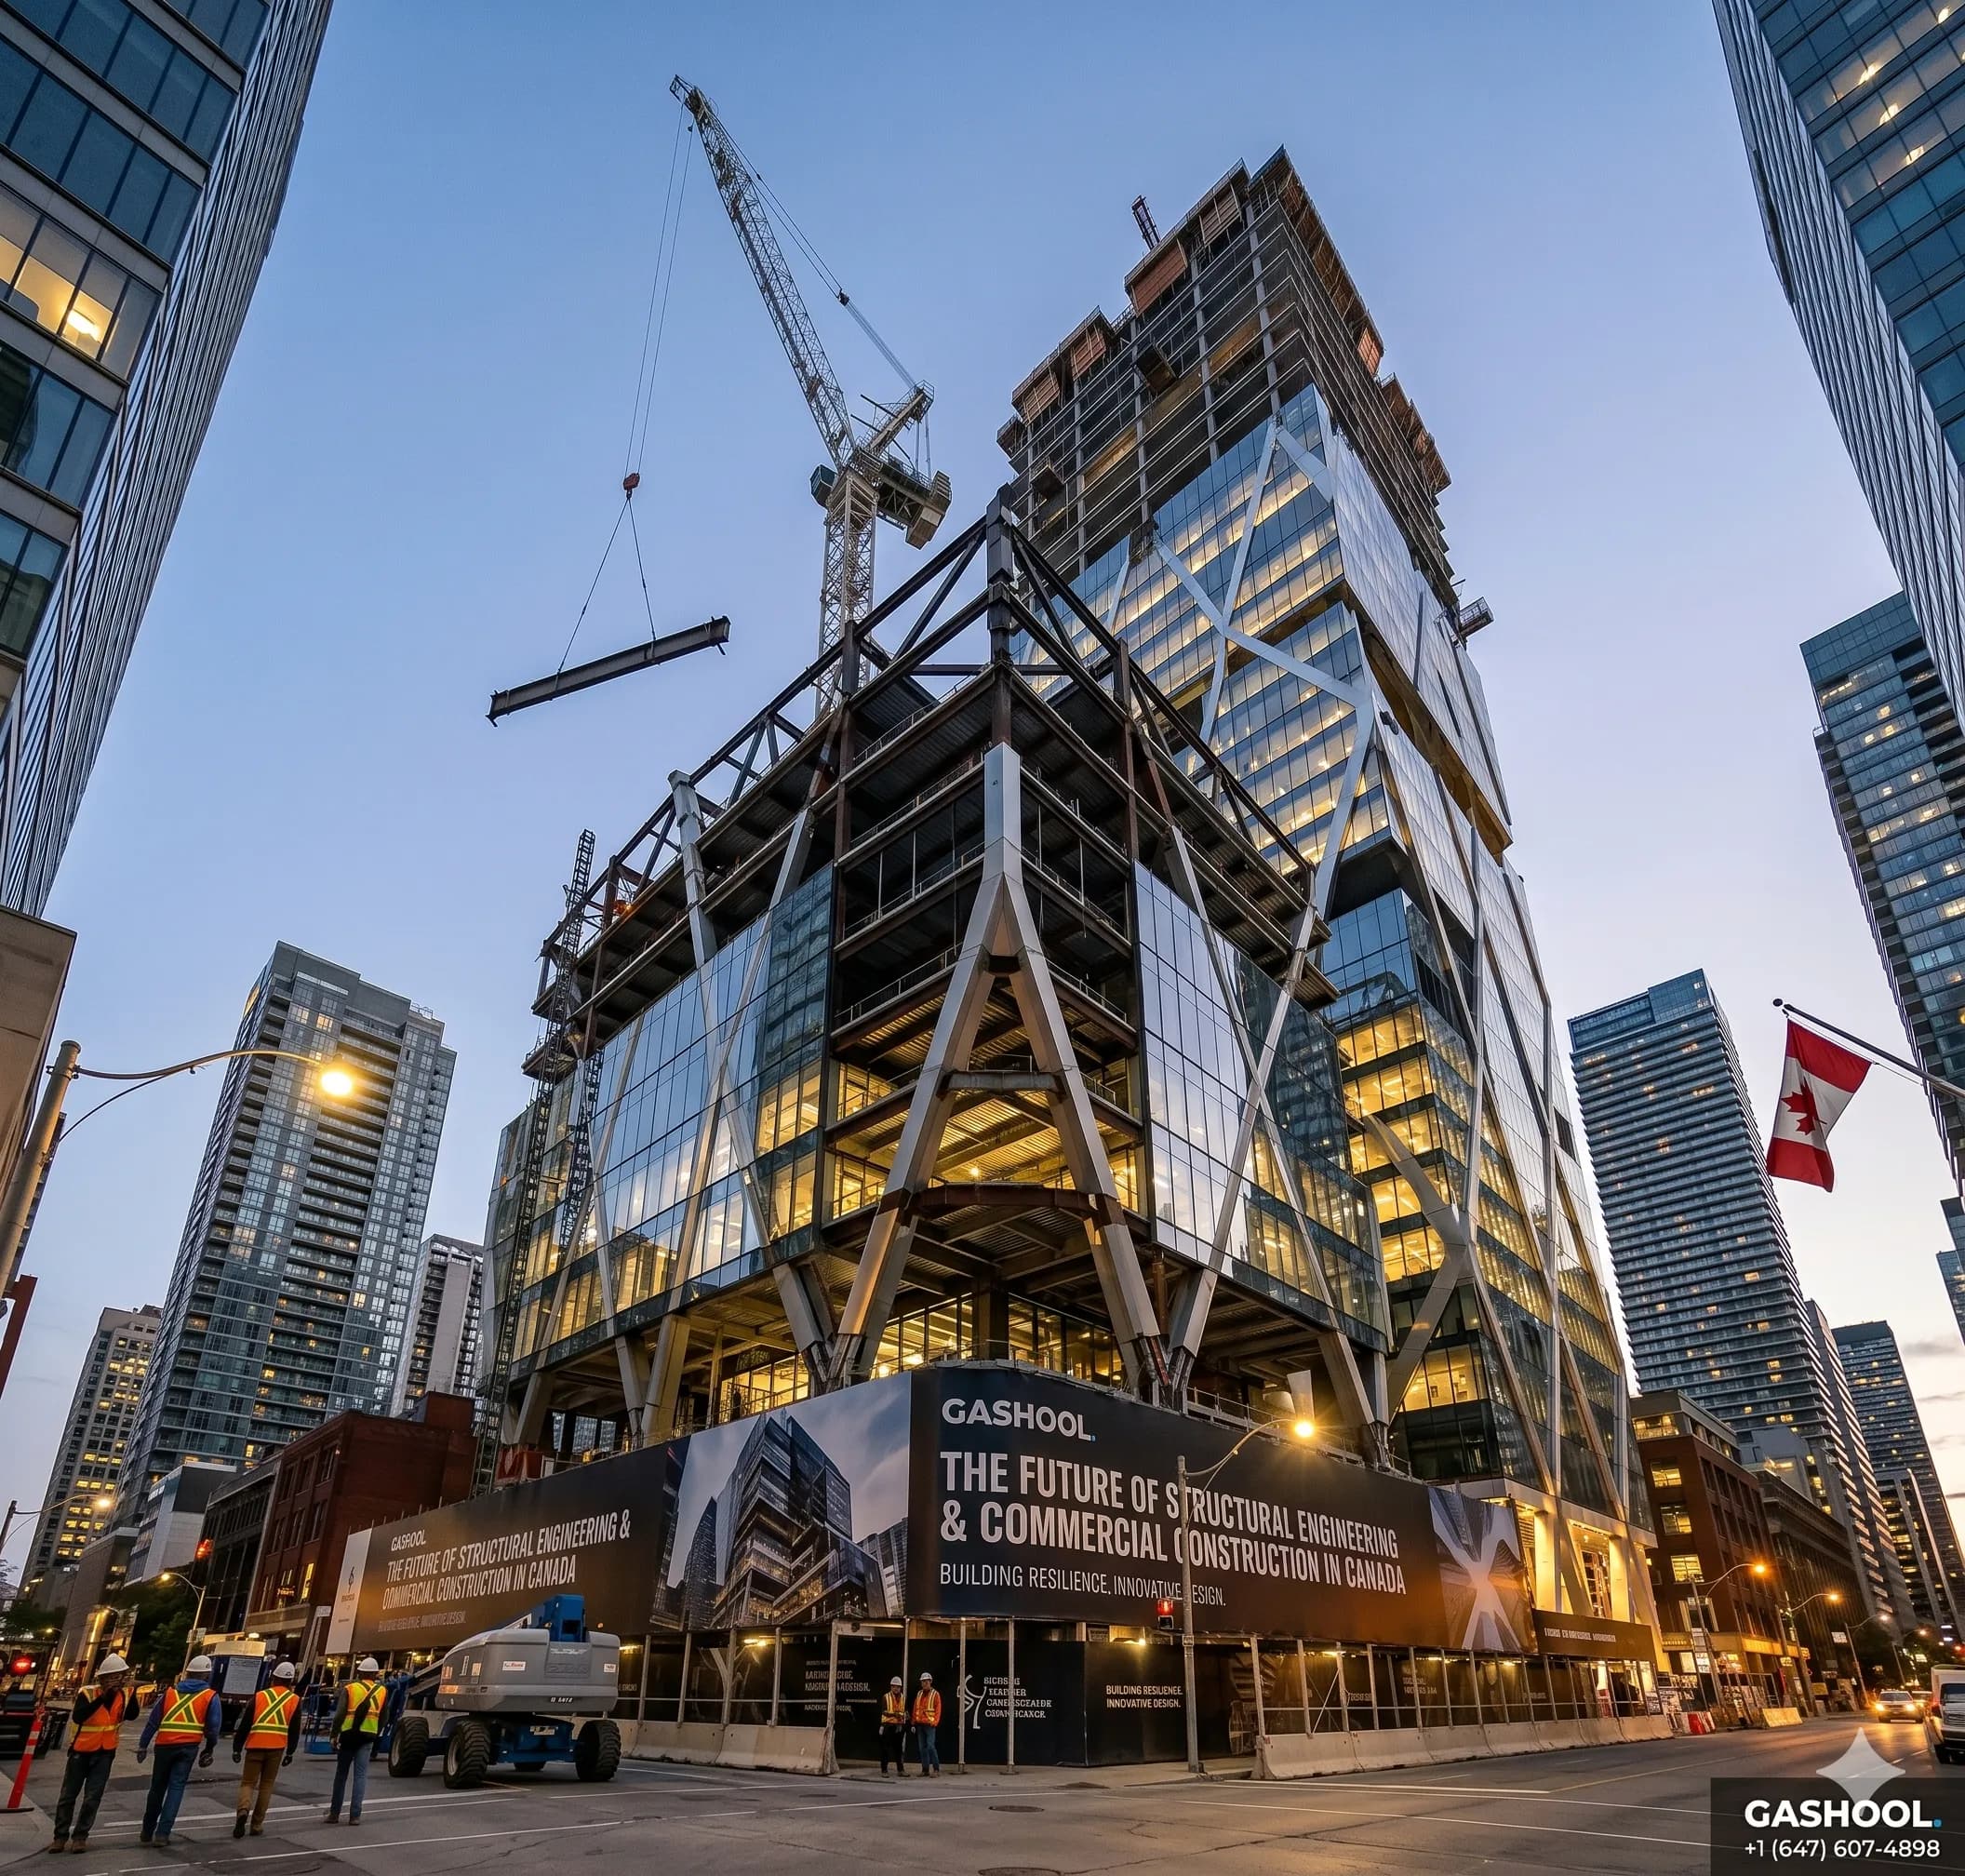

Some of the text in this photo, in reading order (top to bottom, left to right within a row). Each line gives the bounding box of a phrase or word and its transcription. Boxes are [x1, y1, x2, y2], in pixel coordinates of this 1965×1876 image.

[942, 1399, 1096, 1442] GASHOOL.
[940, 1451, 1399, 1560] THE FUTURE OF STRUCTURAL ENGINEERING
[387, 1508, 631, 1583] THE FUTURE OF STRUCTURAL ENGINEERING &
[940, 1499, 967, 1542] &
[981, 1501, 1168, 1562] COMMERCIAL
[1323, 1552, 1342, 1586] IN
[1344, 1556, 1407, 1595] CANADA
[437, 1565, 513, 1602] CONSTRUCTION
[514, 1563, 527, 1591] IN
[528, 1554, 576, 1589] CANADA
[940, 1562, 1226, 1606] BUILDING RESILIENCE. INNOVATIVE ESIGN.
[1106, 1684, 1142, 1695] BUILDING
